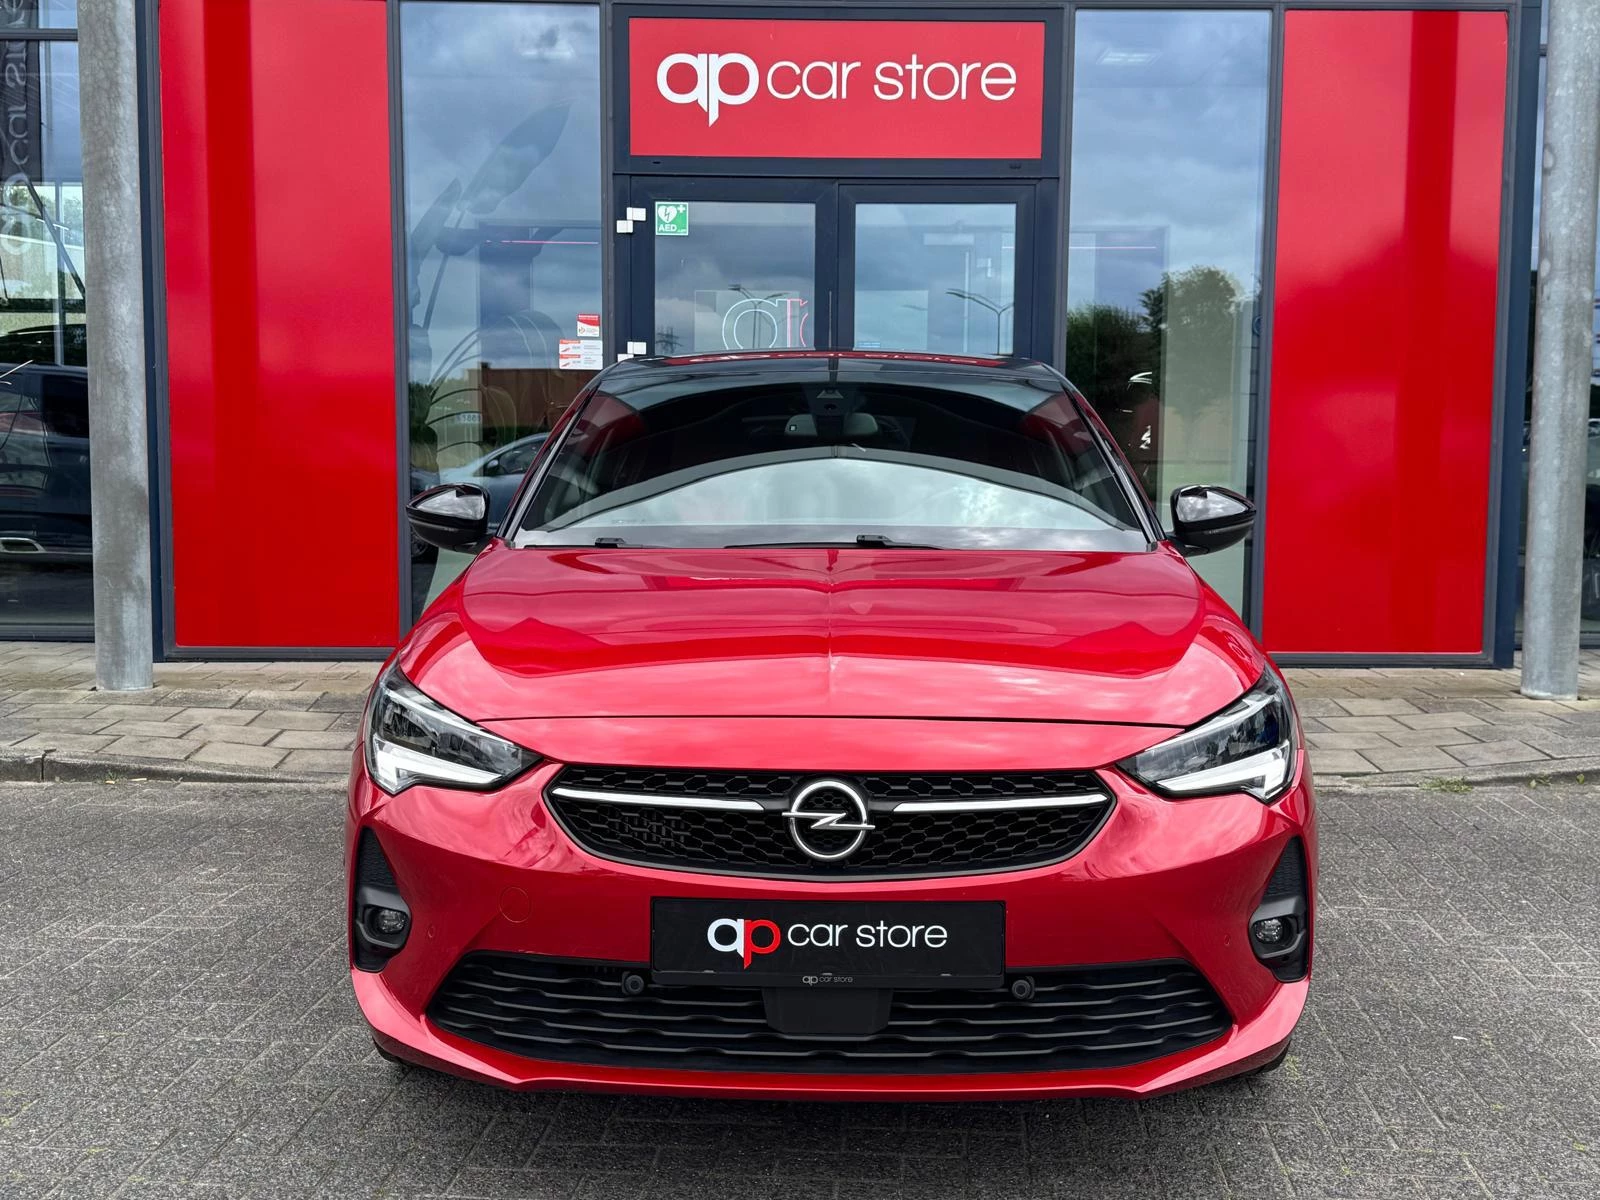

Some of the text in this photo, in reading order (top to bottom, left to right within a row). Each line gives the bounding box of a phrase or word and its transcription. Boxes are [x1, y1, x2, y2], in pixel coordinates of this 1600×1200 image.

[657, 53, 1017, 126] ap car store
[658, 223, 678, 232] AED
[706, 918, 948, 970] ap car store
